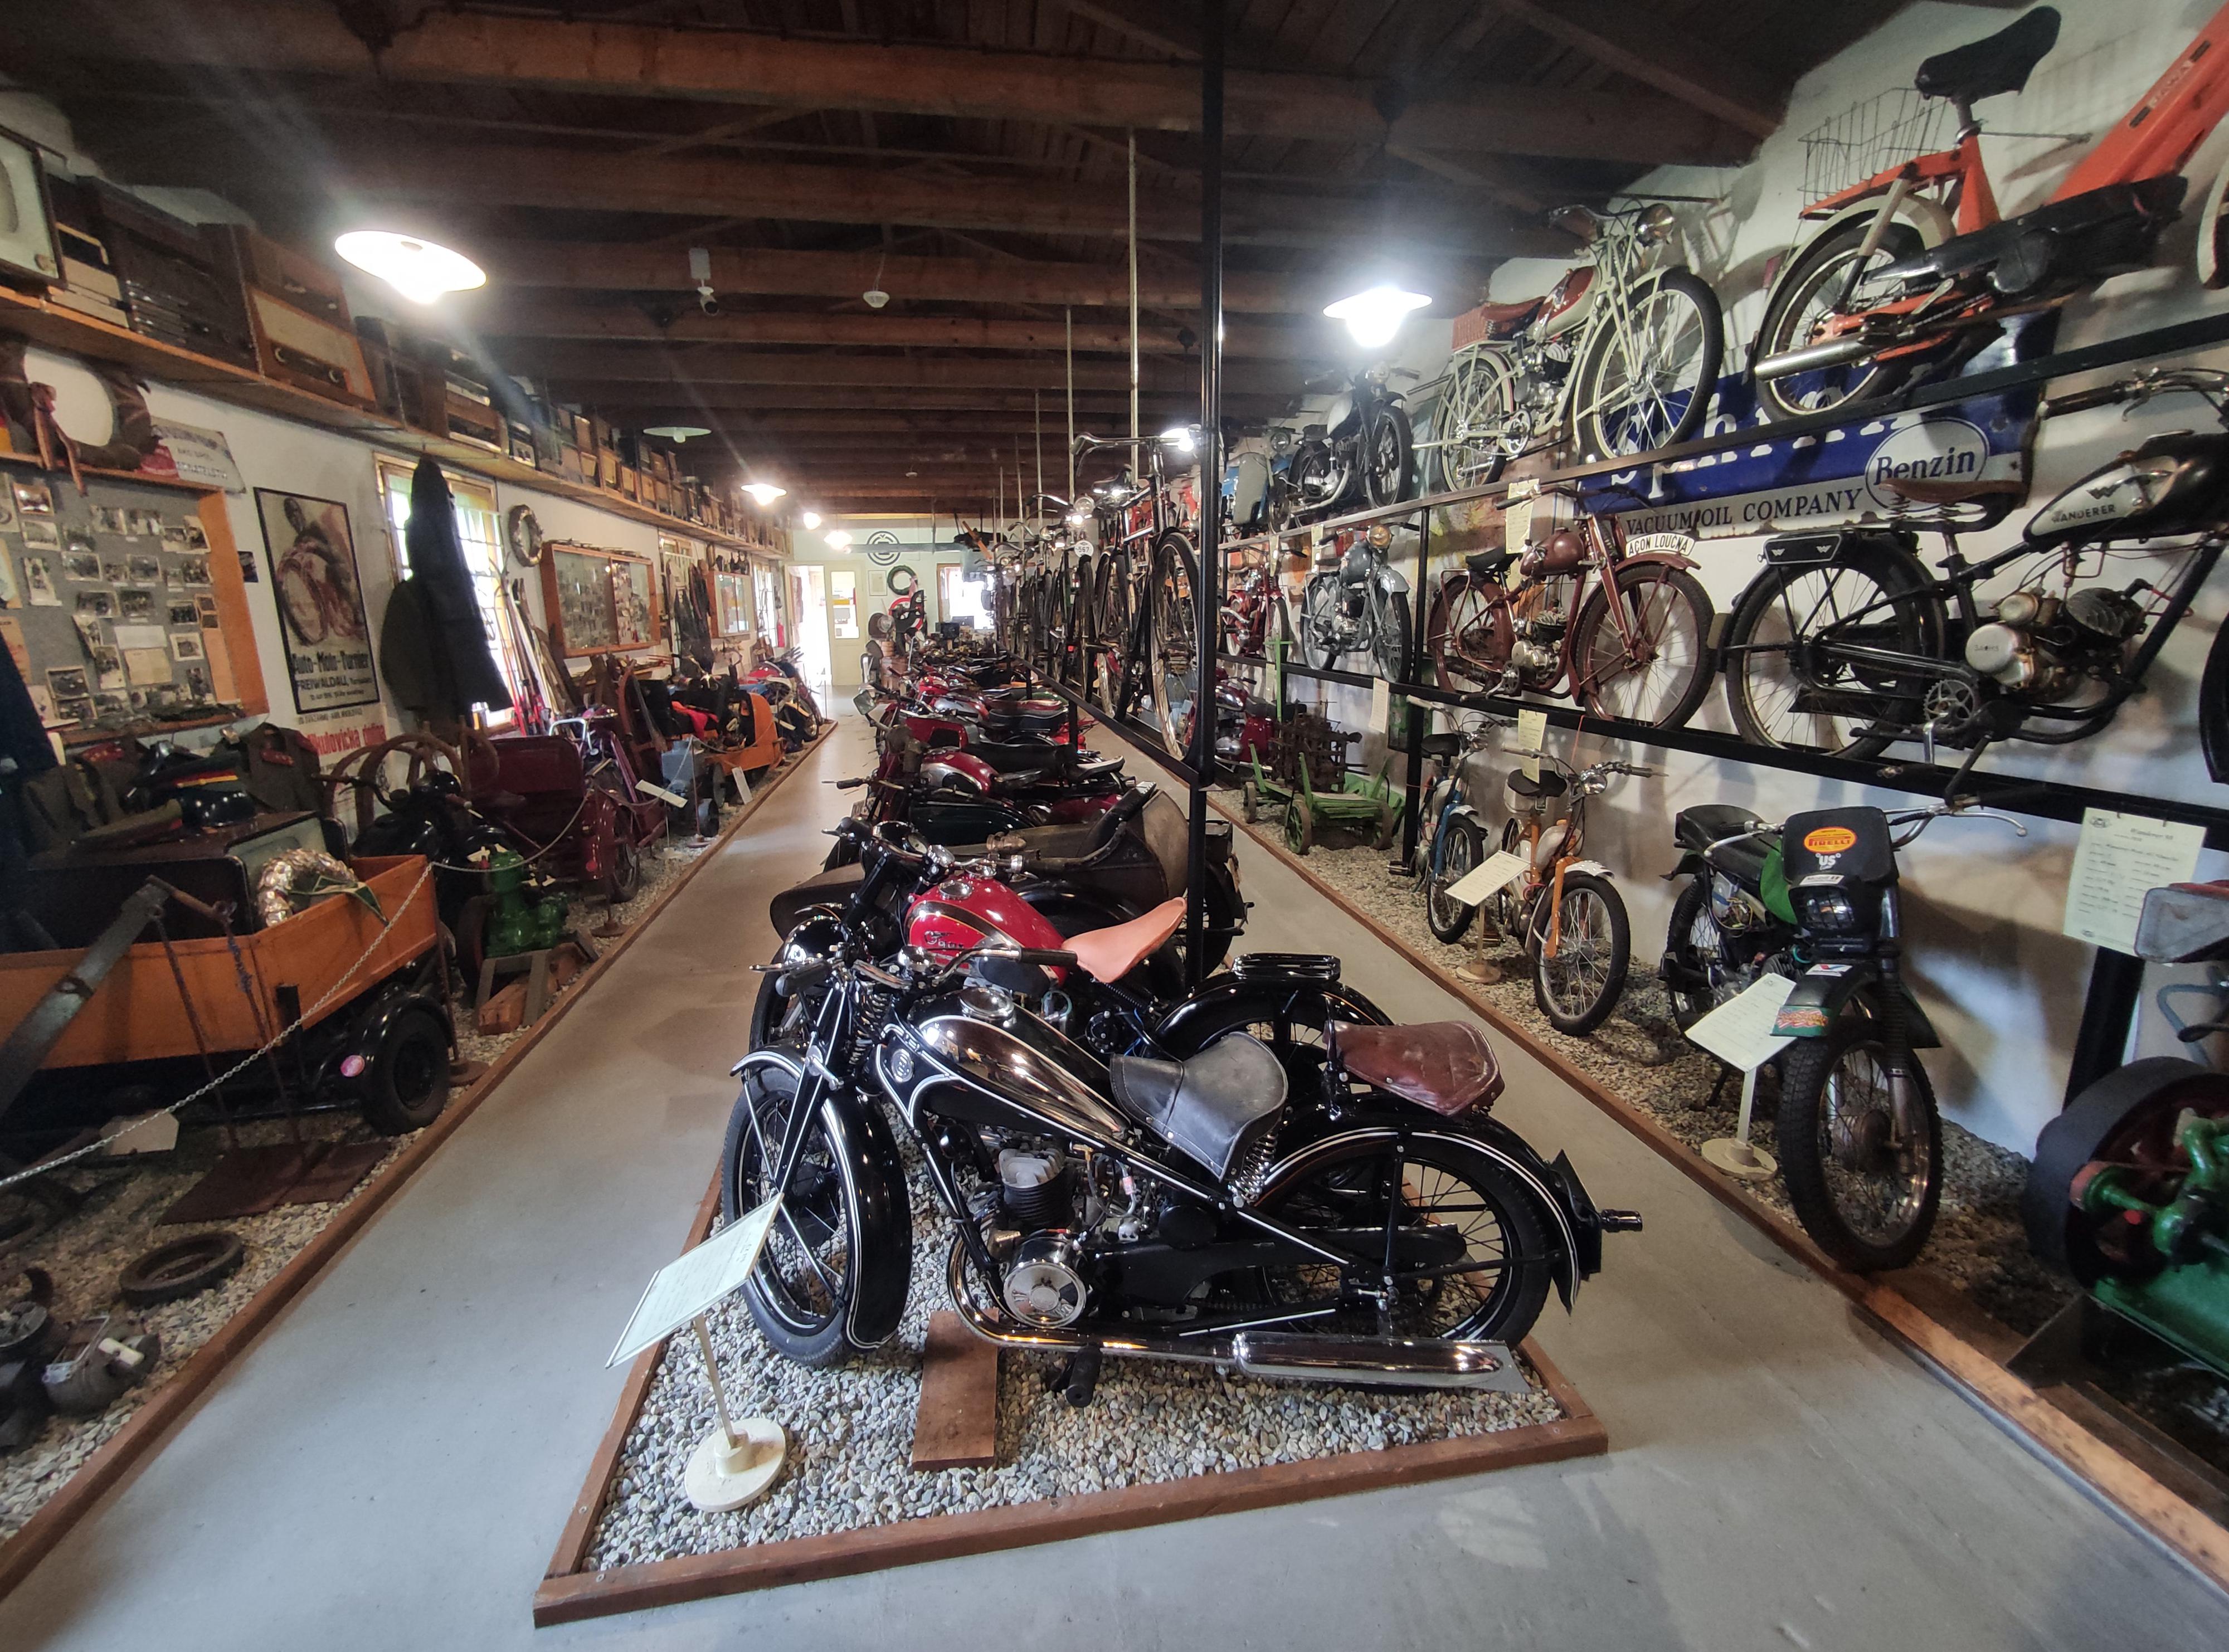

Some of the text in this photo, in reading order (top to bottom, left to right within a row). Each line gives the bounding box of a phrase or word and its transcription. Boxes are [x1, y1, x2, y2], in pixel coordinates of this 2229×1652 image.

[1873, 446, 1975, 486] Benzin
[1626, 488, 1863, 535] VACUUM OIL COMPANY
[1808, 836, 1851, 846] PIRELLI
